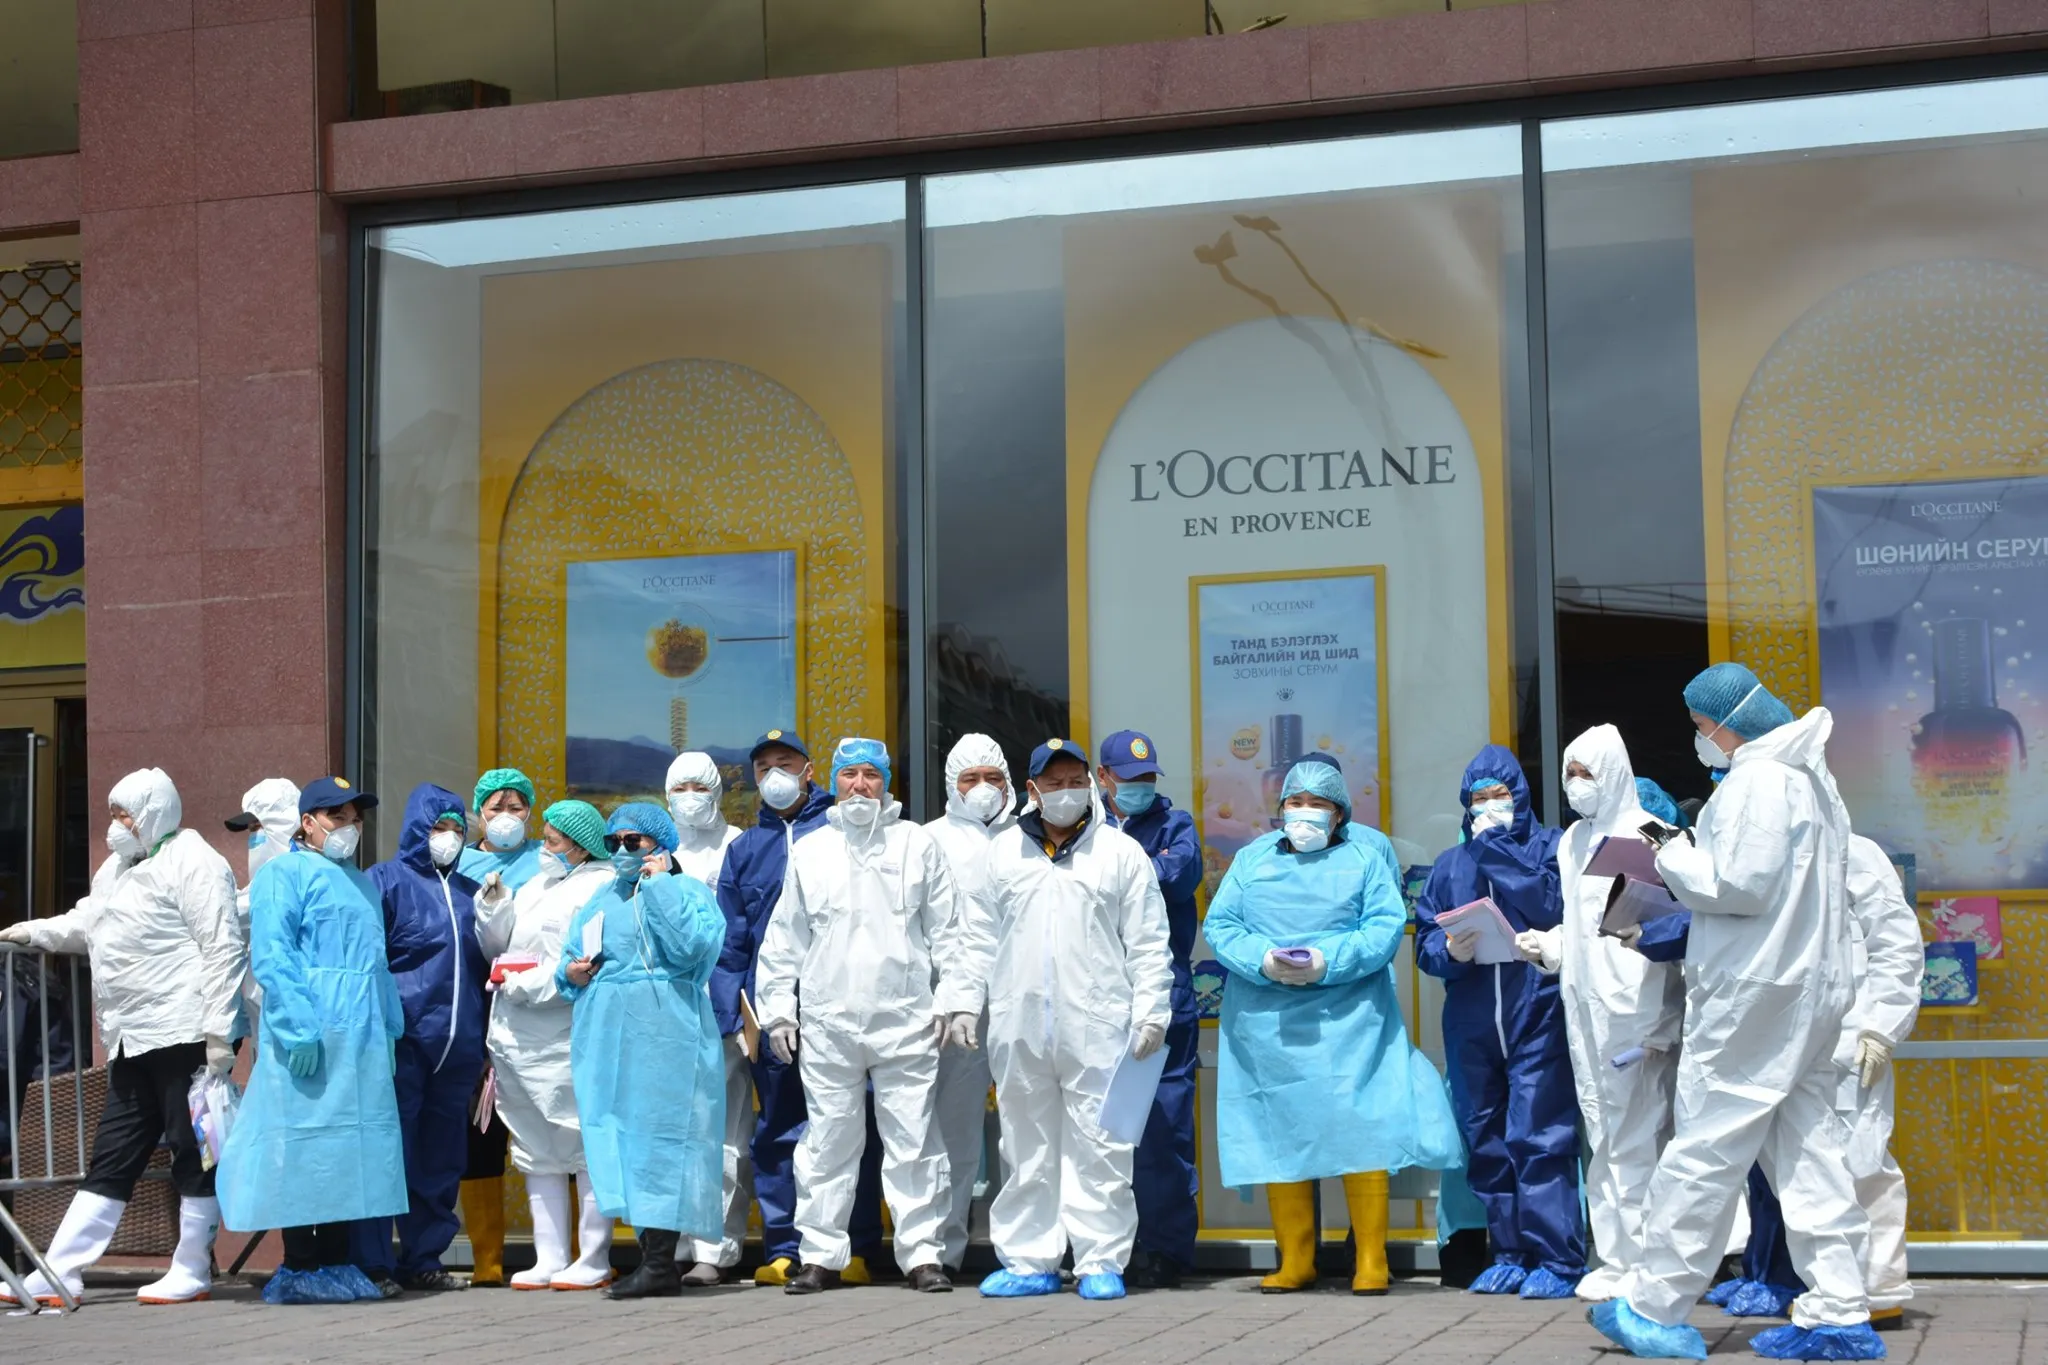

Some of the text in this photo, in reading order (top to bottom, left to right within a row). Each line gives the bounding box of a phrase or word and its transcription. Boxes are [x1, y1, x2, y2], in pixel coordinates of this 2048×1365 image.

[1130, 445, 1456, 502] L'OCCITANE
[1911, 500, 2004, 517] L'OCCITANE
[1183, 508, 1372, 538] EN PROVENCE
[1855, 537, 2048, 565] ШӨНИЙН СЕРУ
[643, 574, 717, 589] L'OCCITANE
[1230, 634, 1339, 650] ТАНД БЭЛЭГЛЭХ
[1213, 648, 1359, 666] БАЙГАЛИЙН ИД ШИД
[1297, 664, 1338, 676] СЕРУМ
[1233, 738, 1257, 748] NEW
